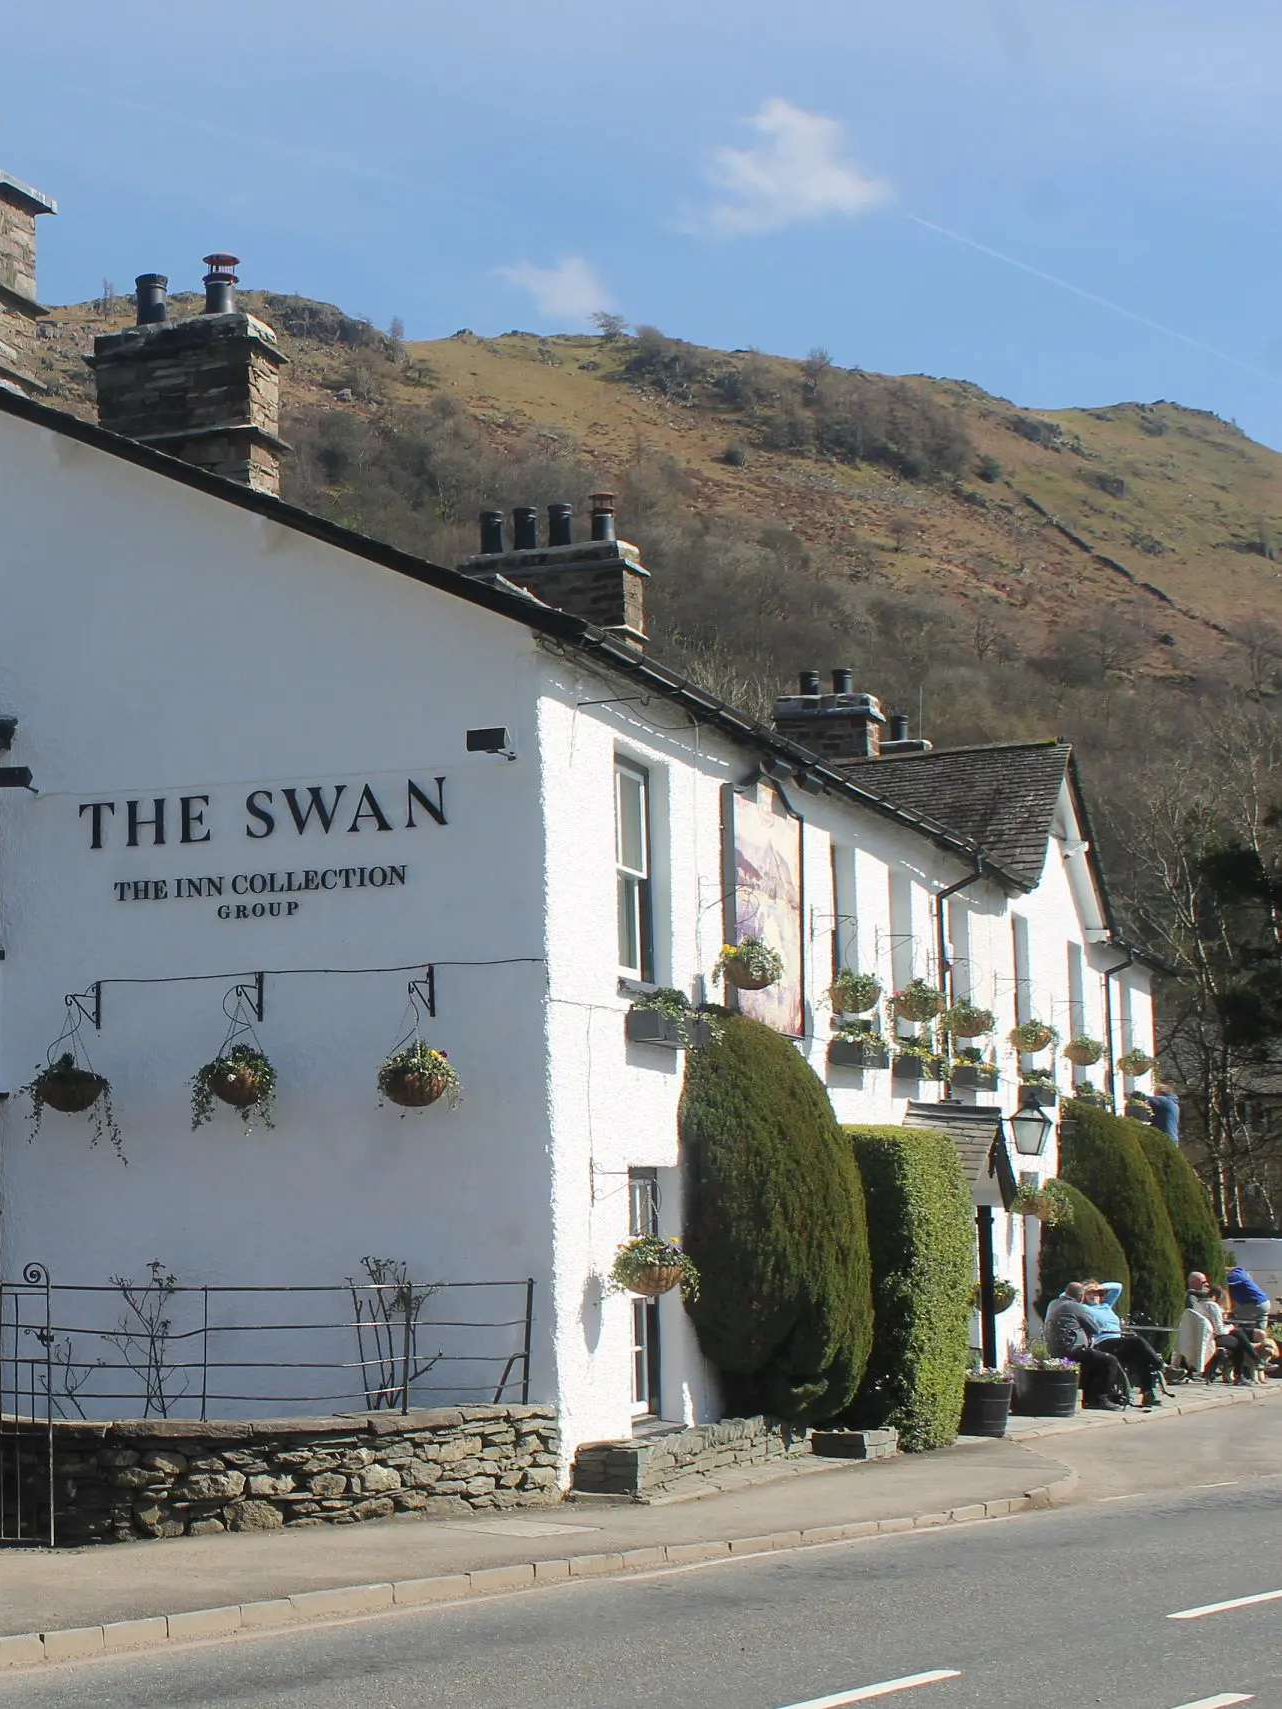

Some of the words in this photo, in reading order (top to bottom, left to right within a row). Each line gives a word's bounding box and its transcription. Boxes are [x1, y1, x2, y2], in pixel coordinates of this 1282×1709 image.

[79, 795, 211, 849] THE
[246, 776, 448, 839] SWAN
[114, 879, 167, 902] THE
[174, 876, 223, 899] INN
[231, 864, 408, 896] COLLECTION
[217, 901, 300, 920] GROUP
